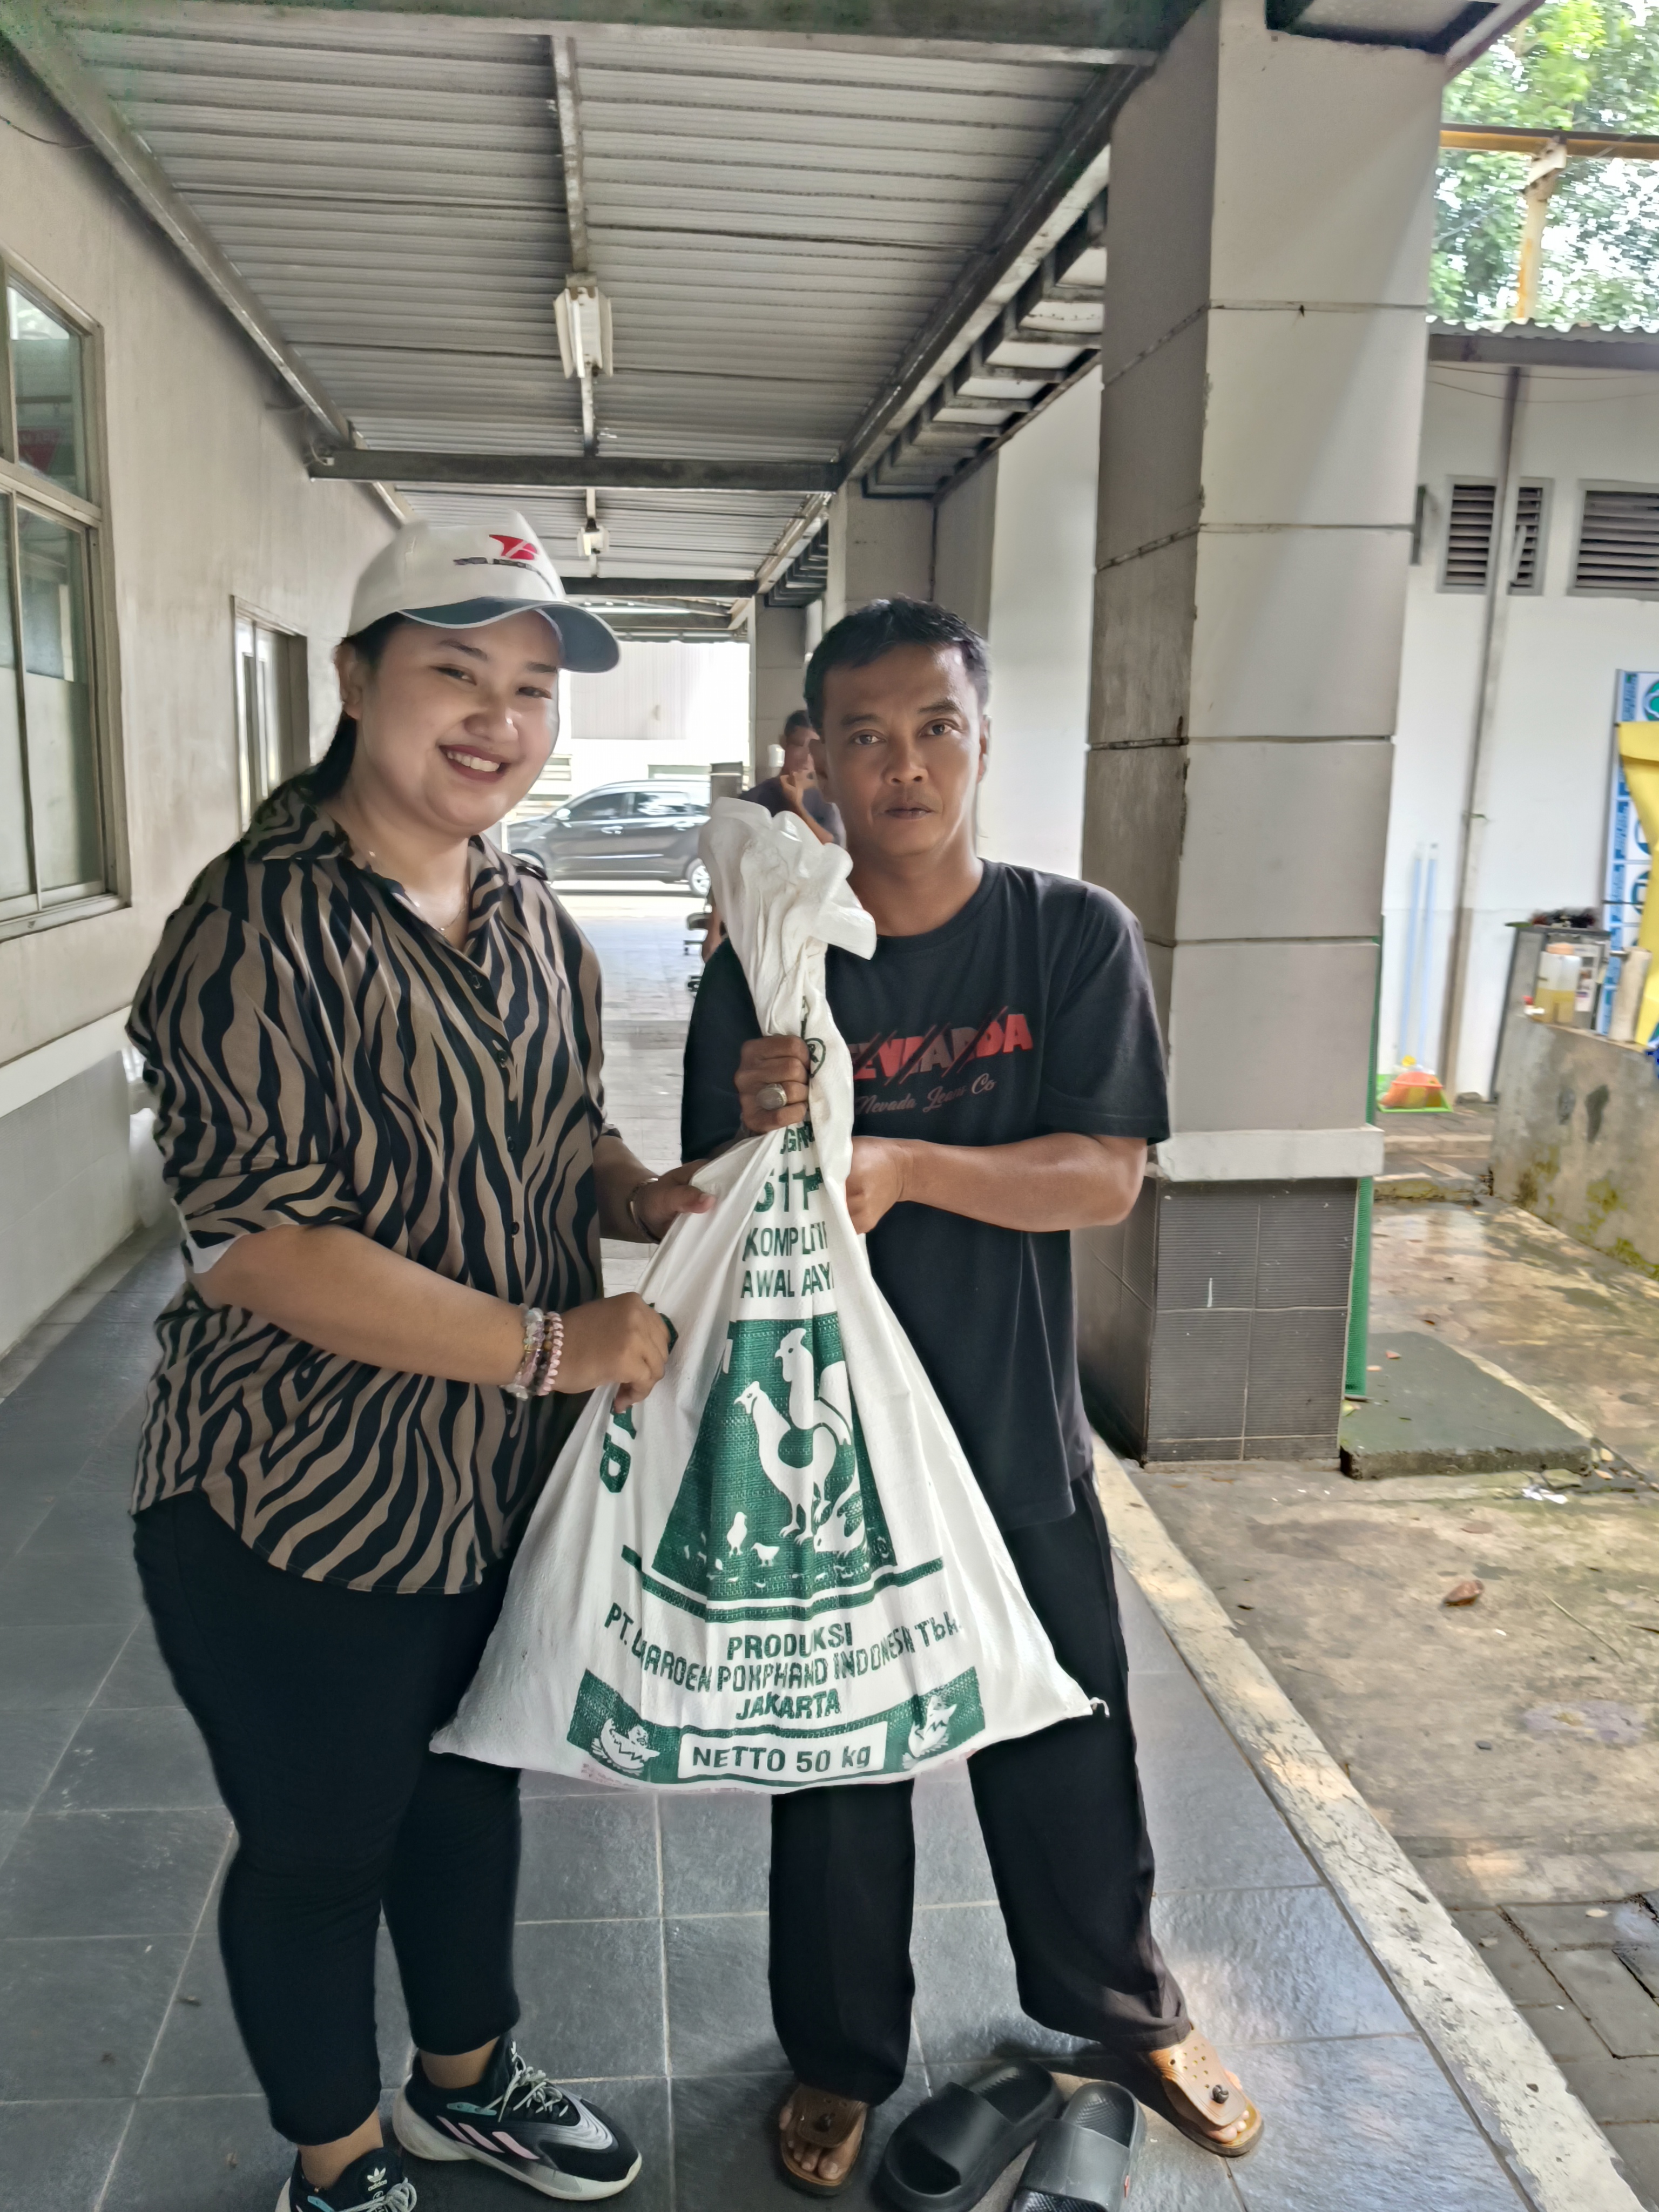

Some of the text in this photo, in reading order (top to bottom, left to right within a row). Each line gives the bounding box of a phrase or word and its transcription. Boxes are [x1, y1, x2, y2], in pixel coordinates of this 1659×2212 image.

[740, 1269, 795, 1298] AWAL
[727, 1622, 853, 1661] PRODUKSI
[736, 1687, 842, 1721] JAKARTA
[692, 1745, 872, 1773] NETTO 50 kg
[368, 2179, 388, 2191] adidas
